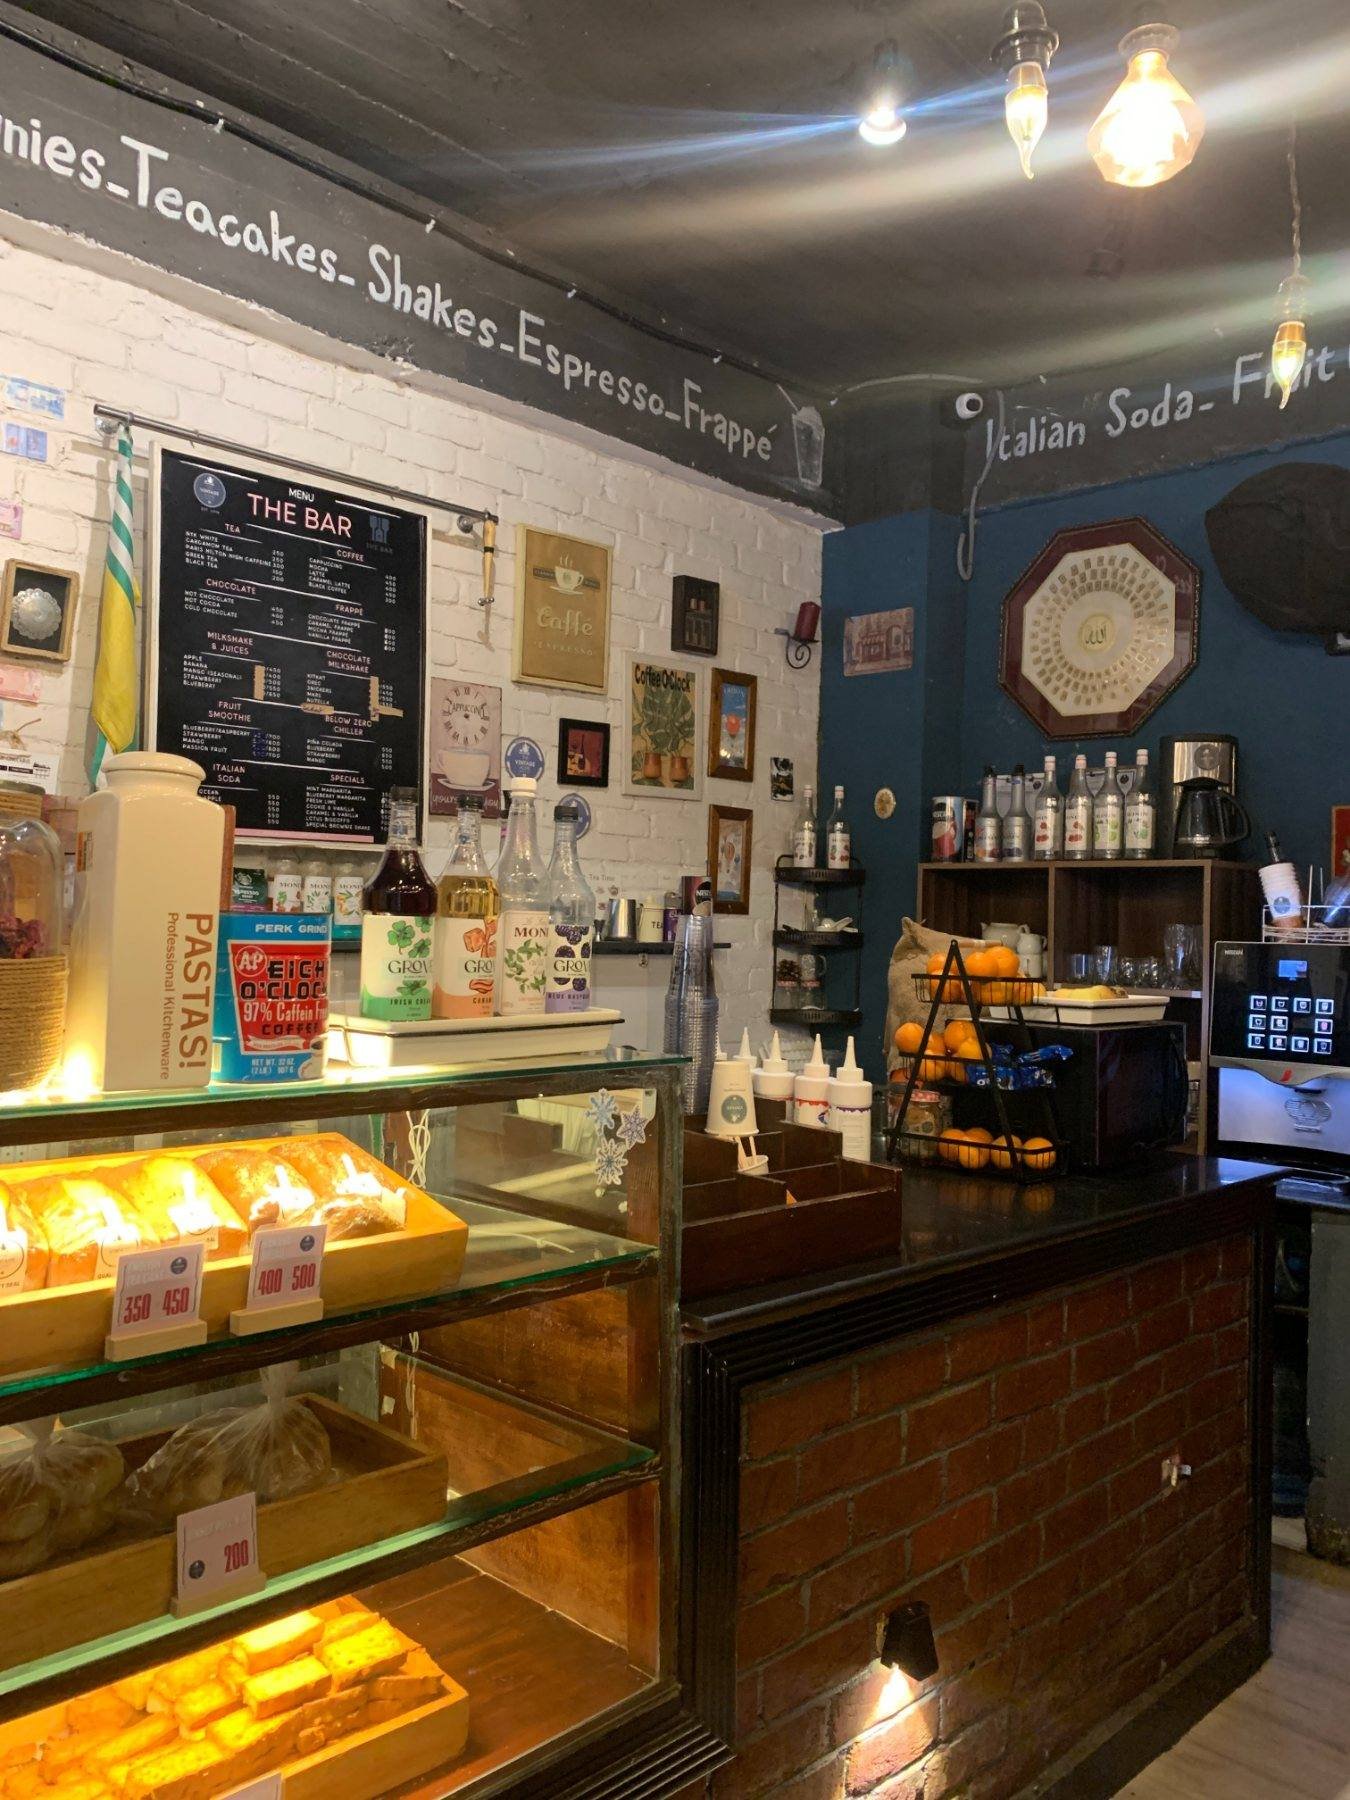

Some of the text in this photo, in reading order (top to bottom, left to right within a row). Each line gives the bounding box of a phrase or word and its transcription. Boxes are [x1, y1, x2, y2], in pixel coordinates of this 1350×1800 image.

[683, 378, 778, 462] Frappé
[986, 416, 1086, 461] Italian
[288, 487, 315, 503] MENU
[247, 492, 352, 538] THE BAR
[225, 523, 240, 533] TEA
[336, 549, 365, 562] COFFEE
[309, 570, 325, 578] LATTE
[206, 578, 257, 595] CHOCOLATE
[207, 631, 254, 646] MILKSHAKE
[220, 644, 250, 655] JUICES
[326, 650, 371, 664] CHOCOLATE
[328, 660, 369, 674] MILKSHAKE
[634, 664, 661, 688] Coffee
[218, 701, 242, 710] FRUIT
[208, 710, 251, 722] SMOOTHIE
[325, 715, 373, 728] BELOW ZERO
[333, 726, 364, 736] CHILLER
[213, 763, 246, 773] ITALIAN
[217, 774, 241, 783] SODA
[330, 774, 365, 784] SPECIALS
[255, 924, 328, 935] PERK GRIND
[160, 912, 179, 1080] Professional Kitchenware
[178, 913, 214, 1069] PASTAS!
[243, 1001, 314, 1022] 97% Caffein
[258, 1263, 316, 1296] 400 500
[123, 1287, 190, 1324] 350 450
[224, 1539, 249, 1574] 200
